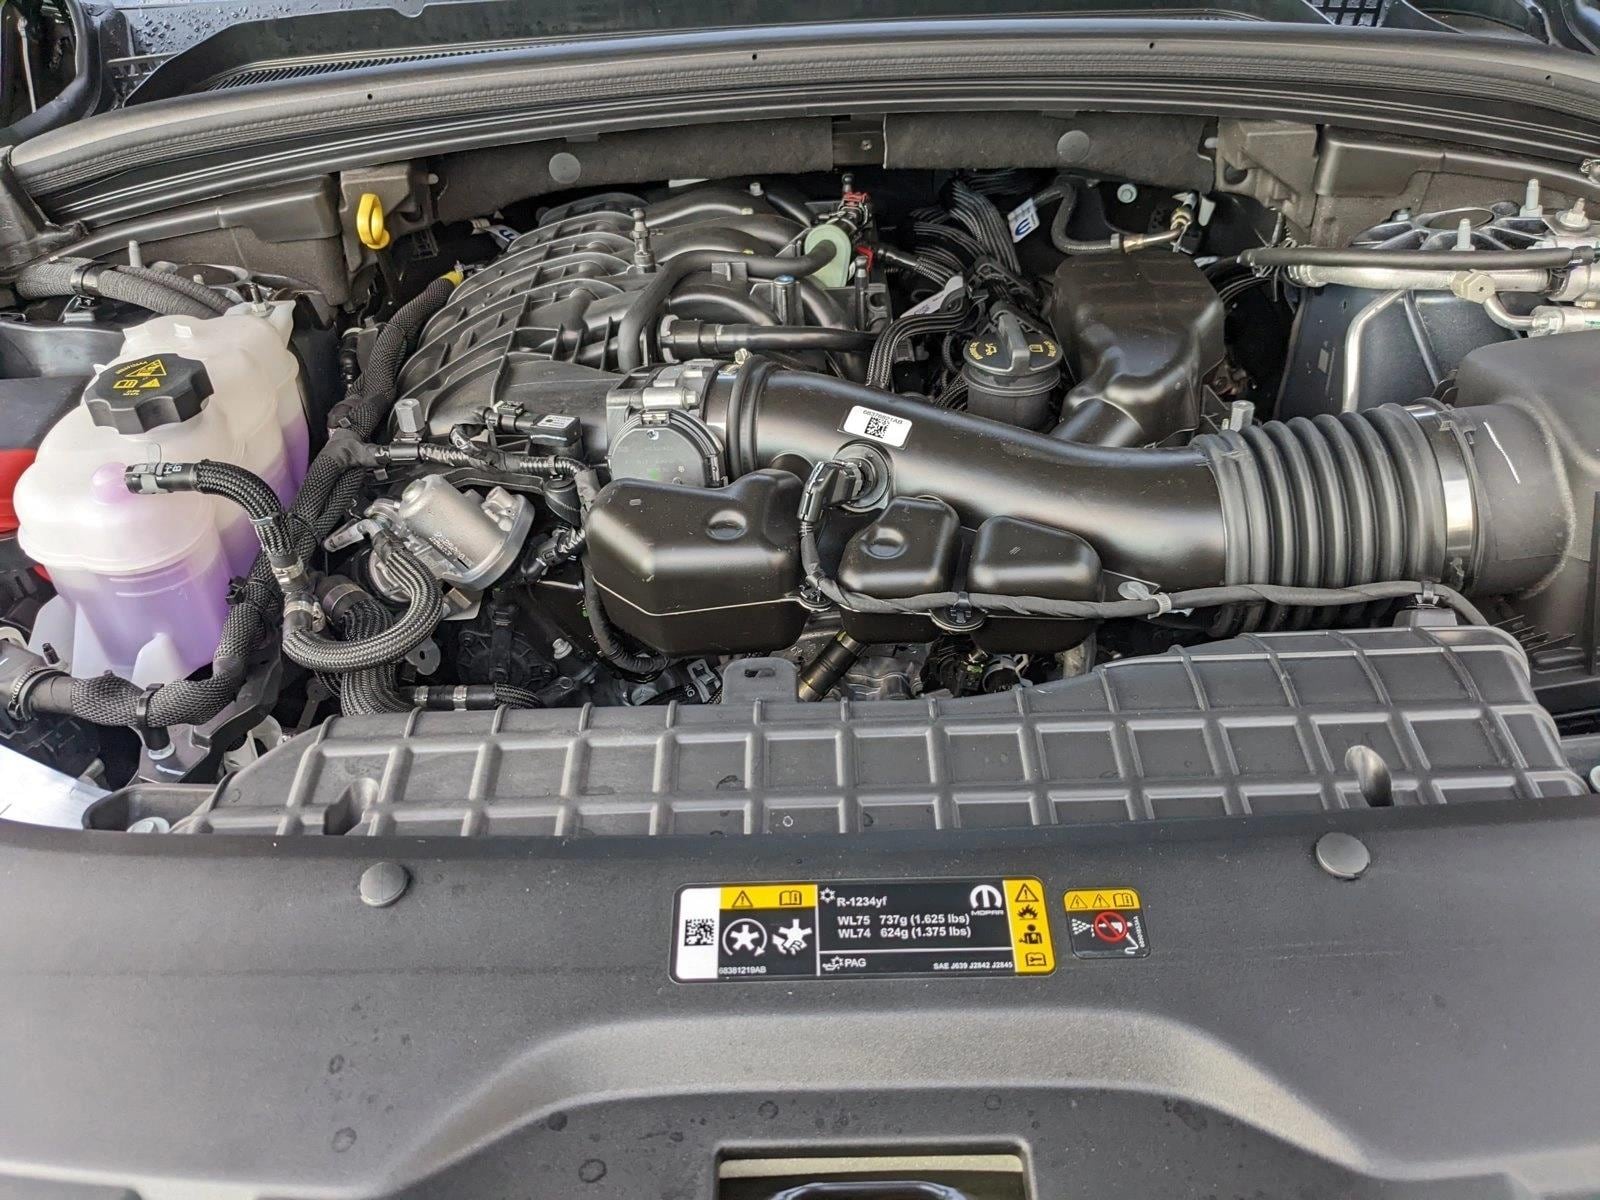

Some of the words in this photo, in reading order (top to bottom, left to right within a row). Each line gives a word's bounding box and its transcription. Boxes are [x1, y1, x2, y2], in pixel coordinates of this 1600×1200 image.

[836, 895, 888, 909] R-1234yf
[837, 915, 871, 926] WL75
[879, 914, 908, 926] 737g
[910, 913, 945, 926] (1.625
[947, 912, 970, 925] lbs)
[838, 927, 871, 939] WL74
[880, 927, 909, 940] 624g
[911, 926, 947, 939] (1.375
[949, 925, 972, 938] lbs)
[844, 958, 867, 968] PAG
